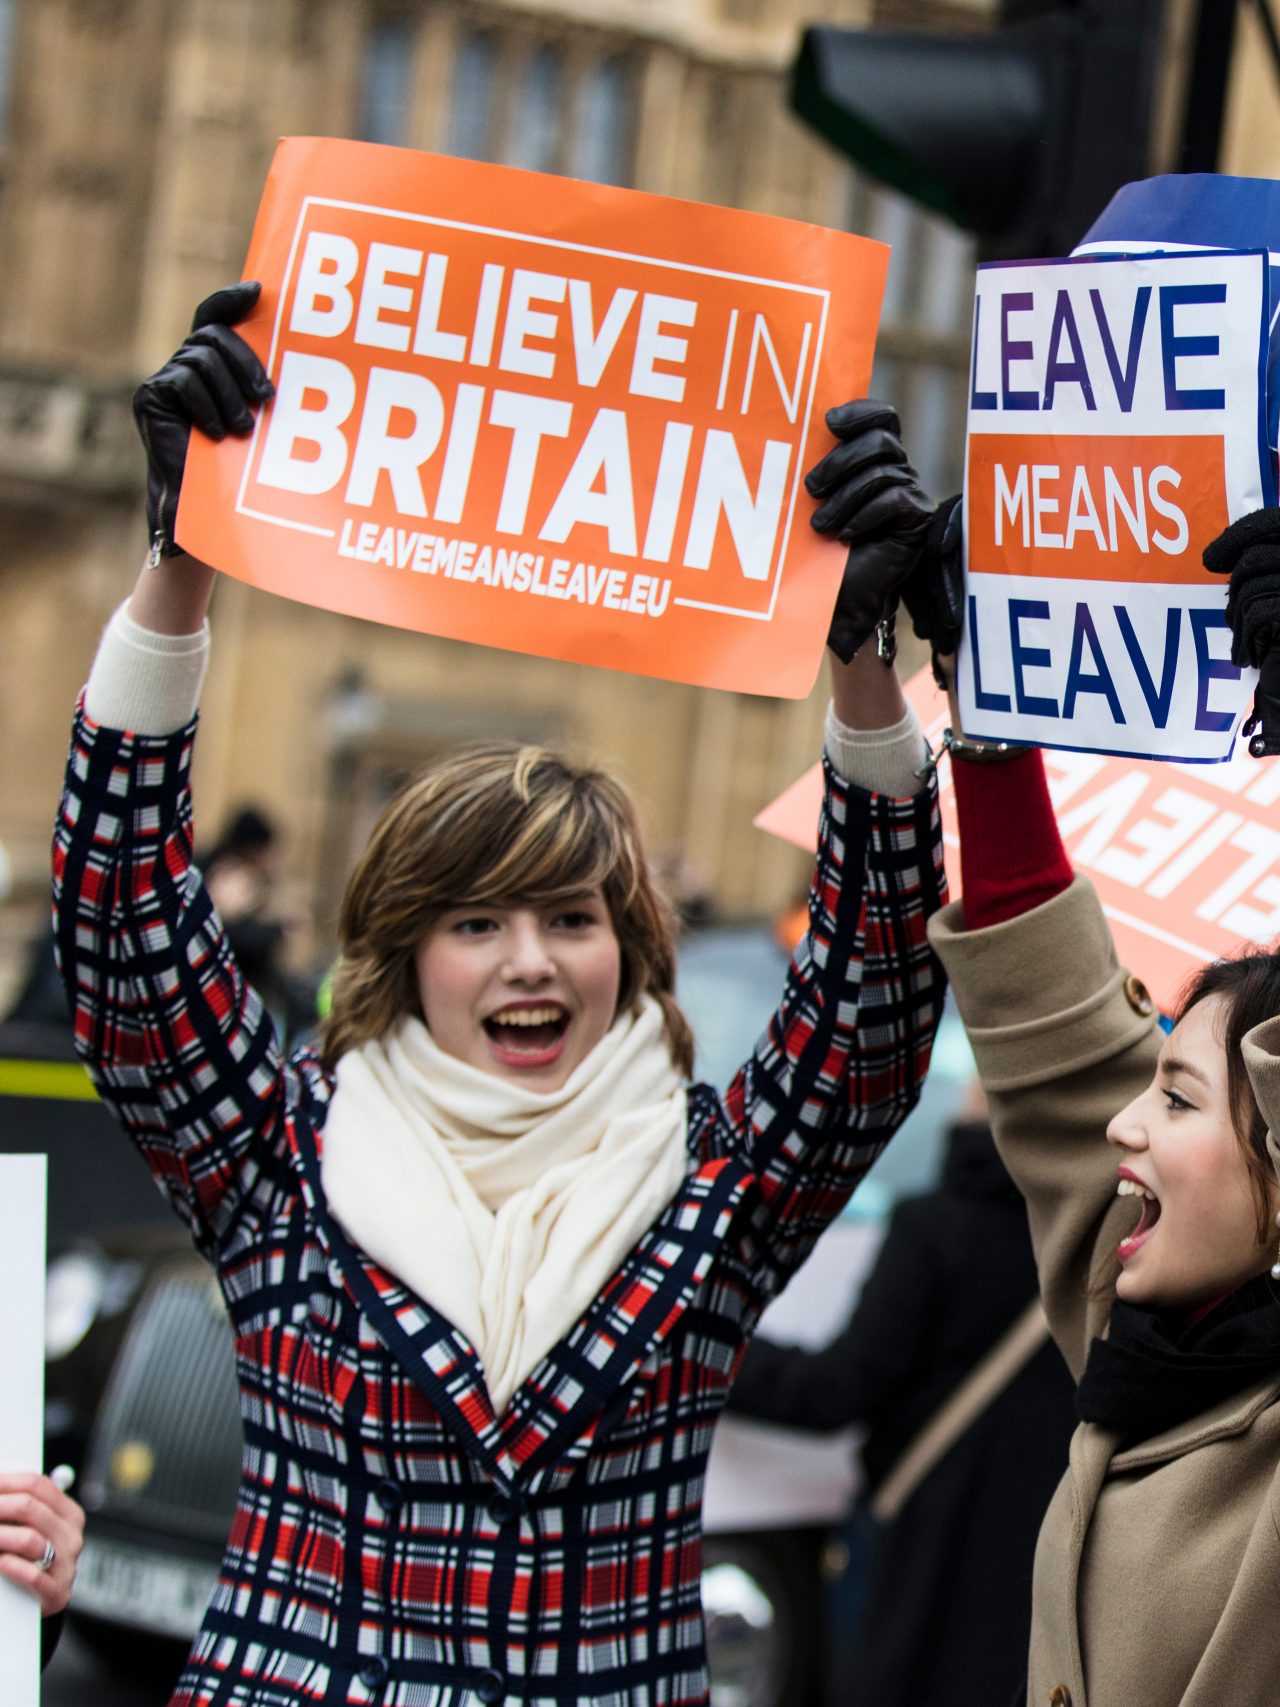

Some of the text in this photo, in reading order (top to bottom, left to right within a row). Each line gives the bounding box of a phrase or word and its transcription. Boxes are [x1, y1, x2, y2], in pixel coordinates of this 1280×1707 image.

[289, 229, 813, 424] BELIEVE IN
[969, 283, 1227, 413] LEAVE
[256, 350, 793, 581] BRITAIN
[994, 463, 1190, 556] MEANS
[337, 518, 673, 618] LEAVEMEANSLEAVE.EU
[968, 594, 1242, 733] LEAVE
